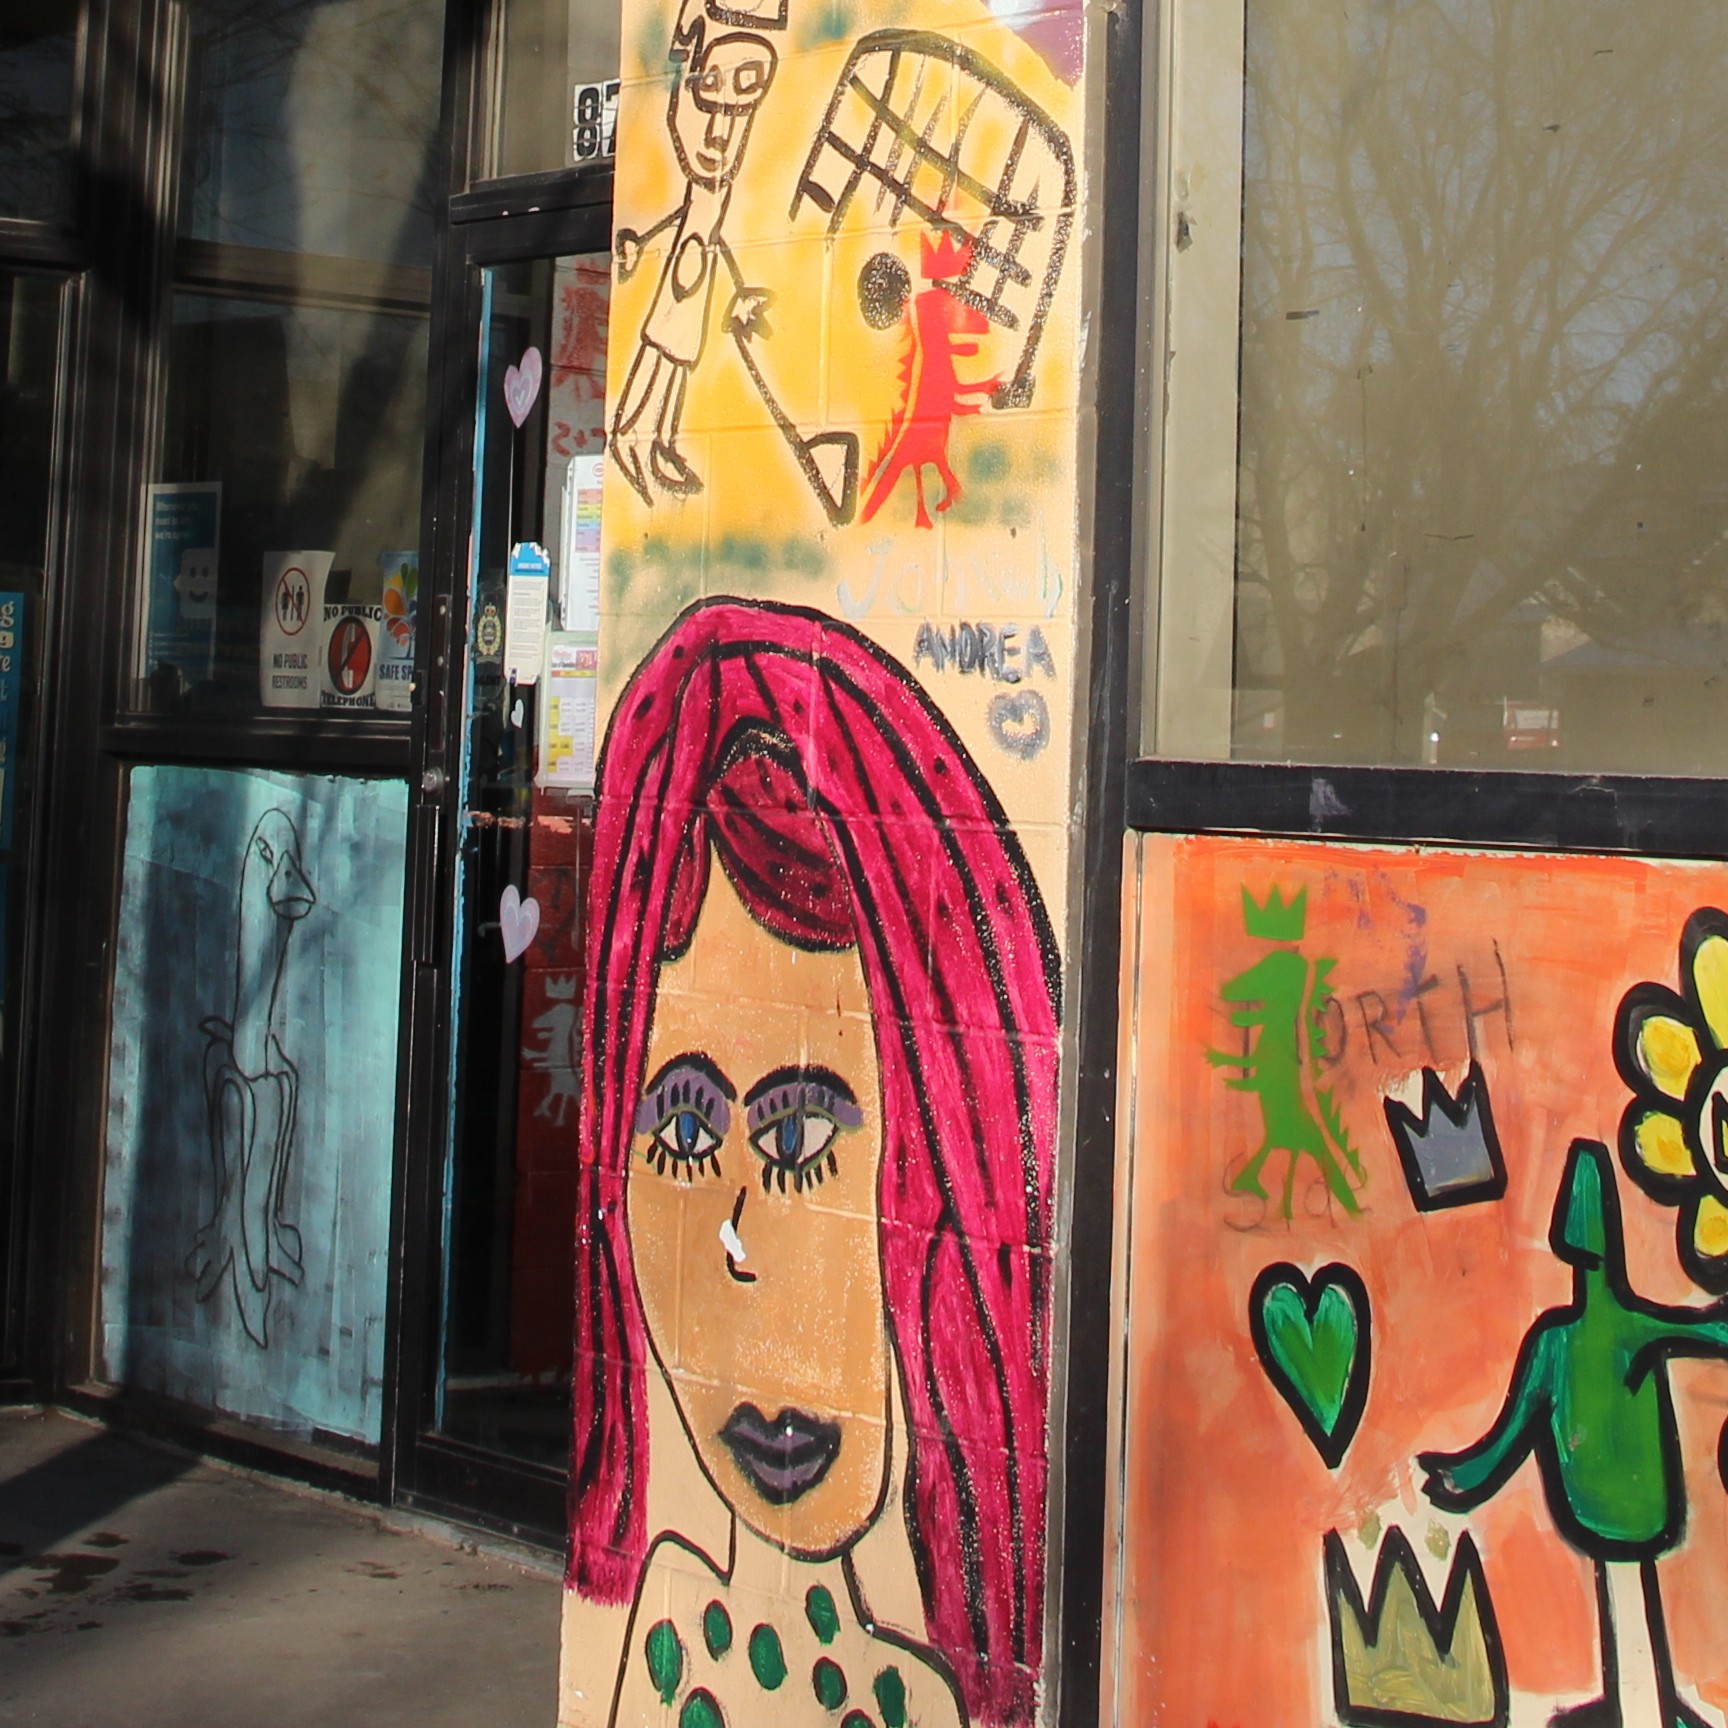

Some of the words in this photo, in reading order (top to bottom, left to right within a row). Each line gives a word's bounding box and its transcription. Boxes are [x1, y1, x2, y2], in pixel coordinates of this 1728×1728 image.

[323, 607, 339, 622] NO
[340, 605, 383, 622] PUBLIC
[913, 619, 1057, 684] ANDREA
[273, 653, 283, 669] NO
[283, 653, 308, 669] PUBLIC
[379, 663, 400, 680] SAFE
[272, 674, 308, 689] RESTROOMS
[320, 689, 376, 707] TELEPHONE
